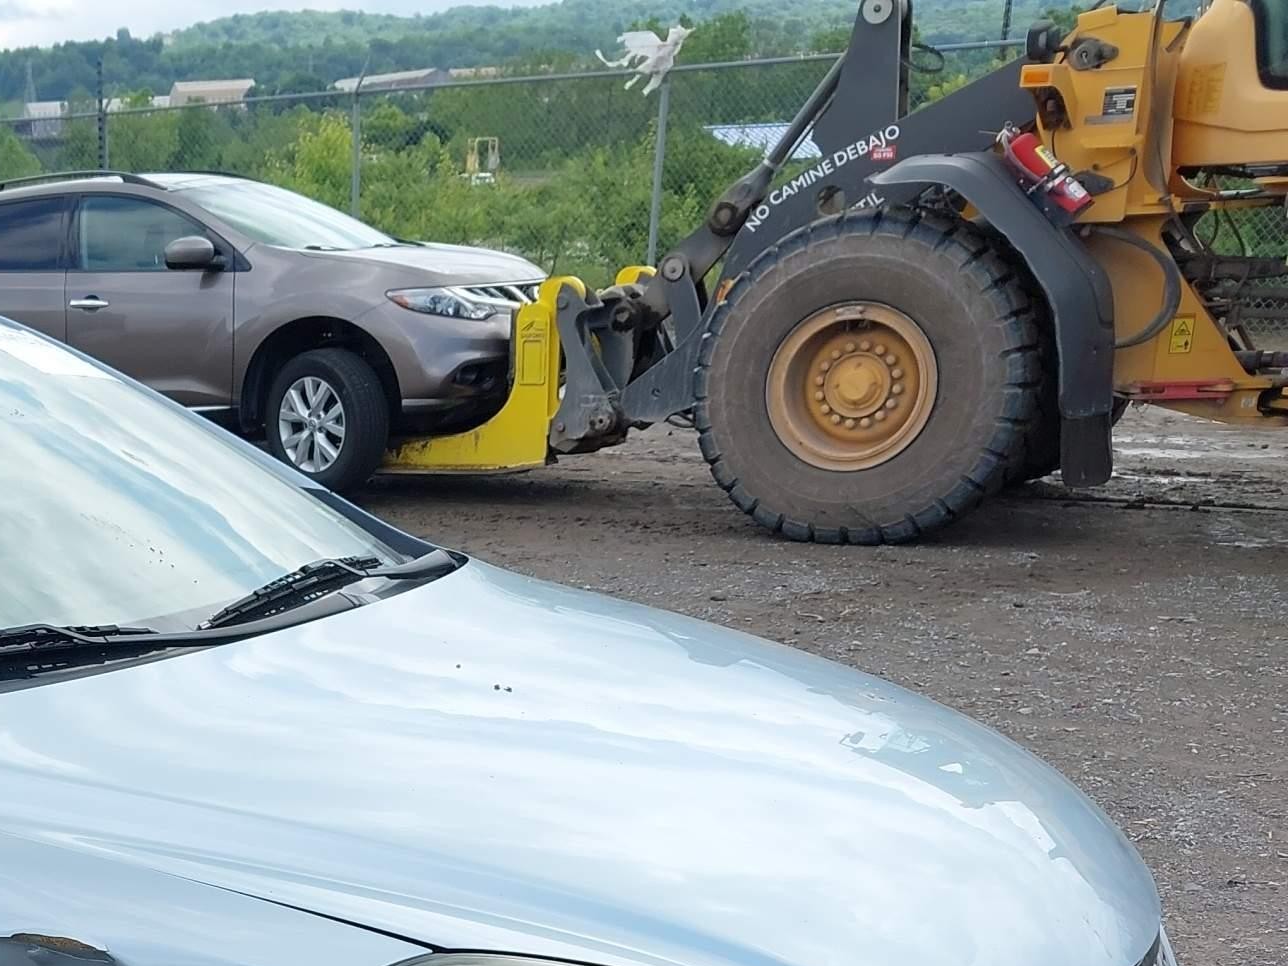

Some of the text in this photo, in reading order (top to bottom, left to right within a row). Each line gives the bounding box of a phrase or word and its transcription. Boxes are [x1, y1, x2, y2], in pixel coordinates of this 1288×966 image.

[745, 125, 900, 232] NO CAMINE DEBAJO
[850, 192, 886, 209] TIL
